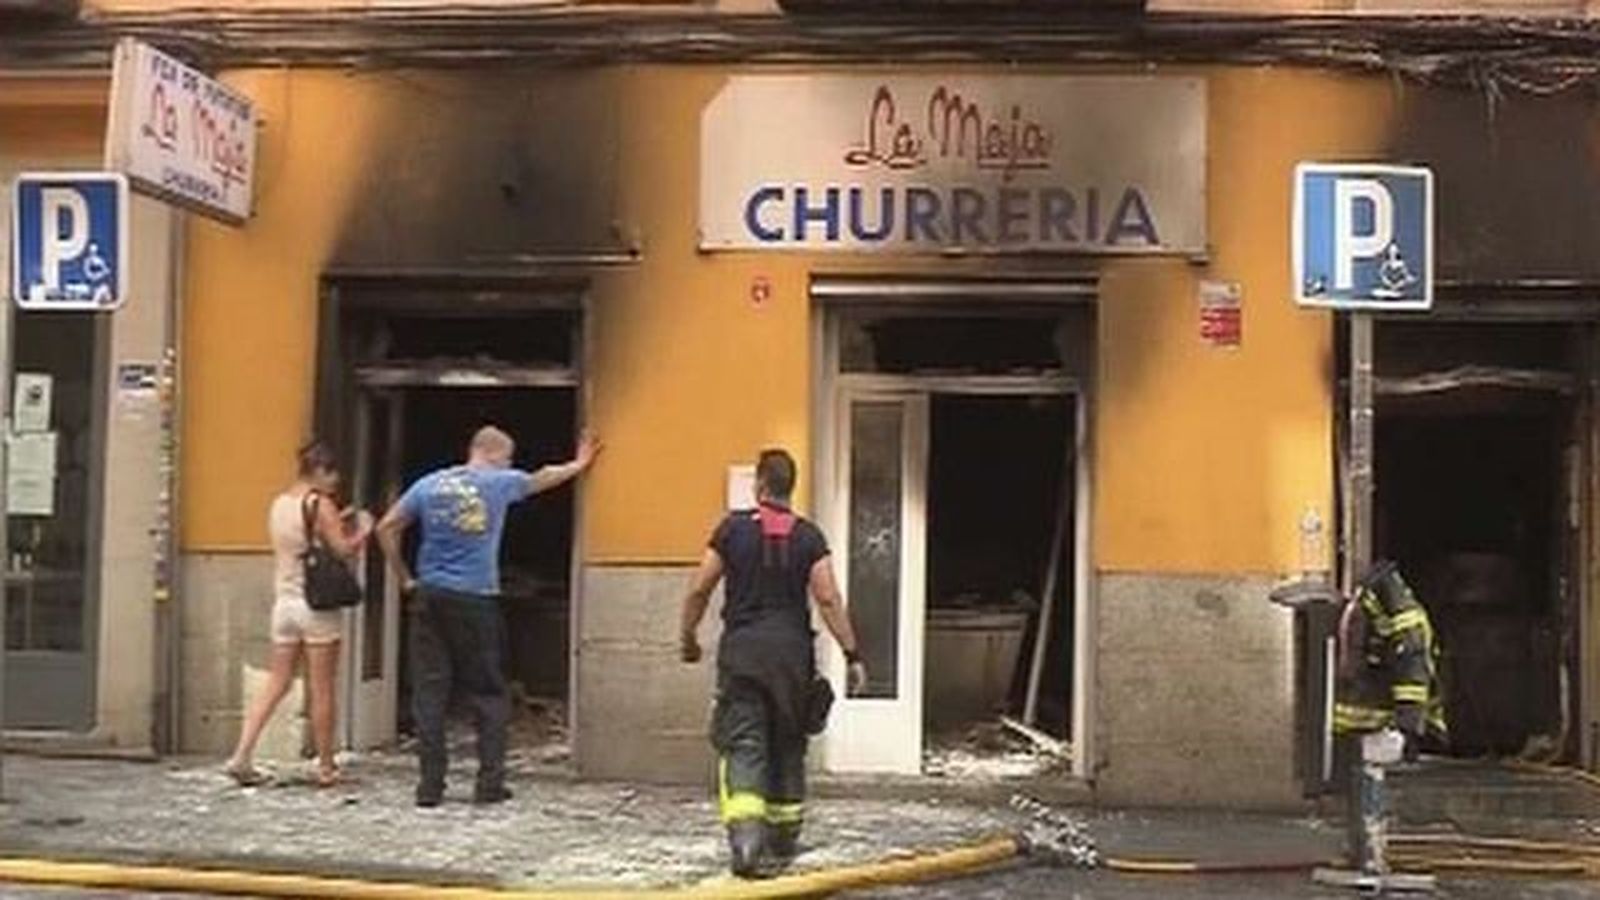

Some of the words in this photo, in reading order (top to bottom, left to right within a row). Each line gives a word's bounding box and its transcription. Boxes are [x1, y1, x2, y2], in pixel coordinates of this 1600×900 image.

[141, 83, 178, 152] La
[844, 85, 927, 169] La
[927, 85, 1052, 181] Maja
[42, 187, 89, 289] P
[744, 186, 1161, 244] CHURRERIA
[1334, 179, 1393, 290] P
